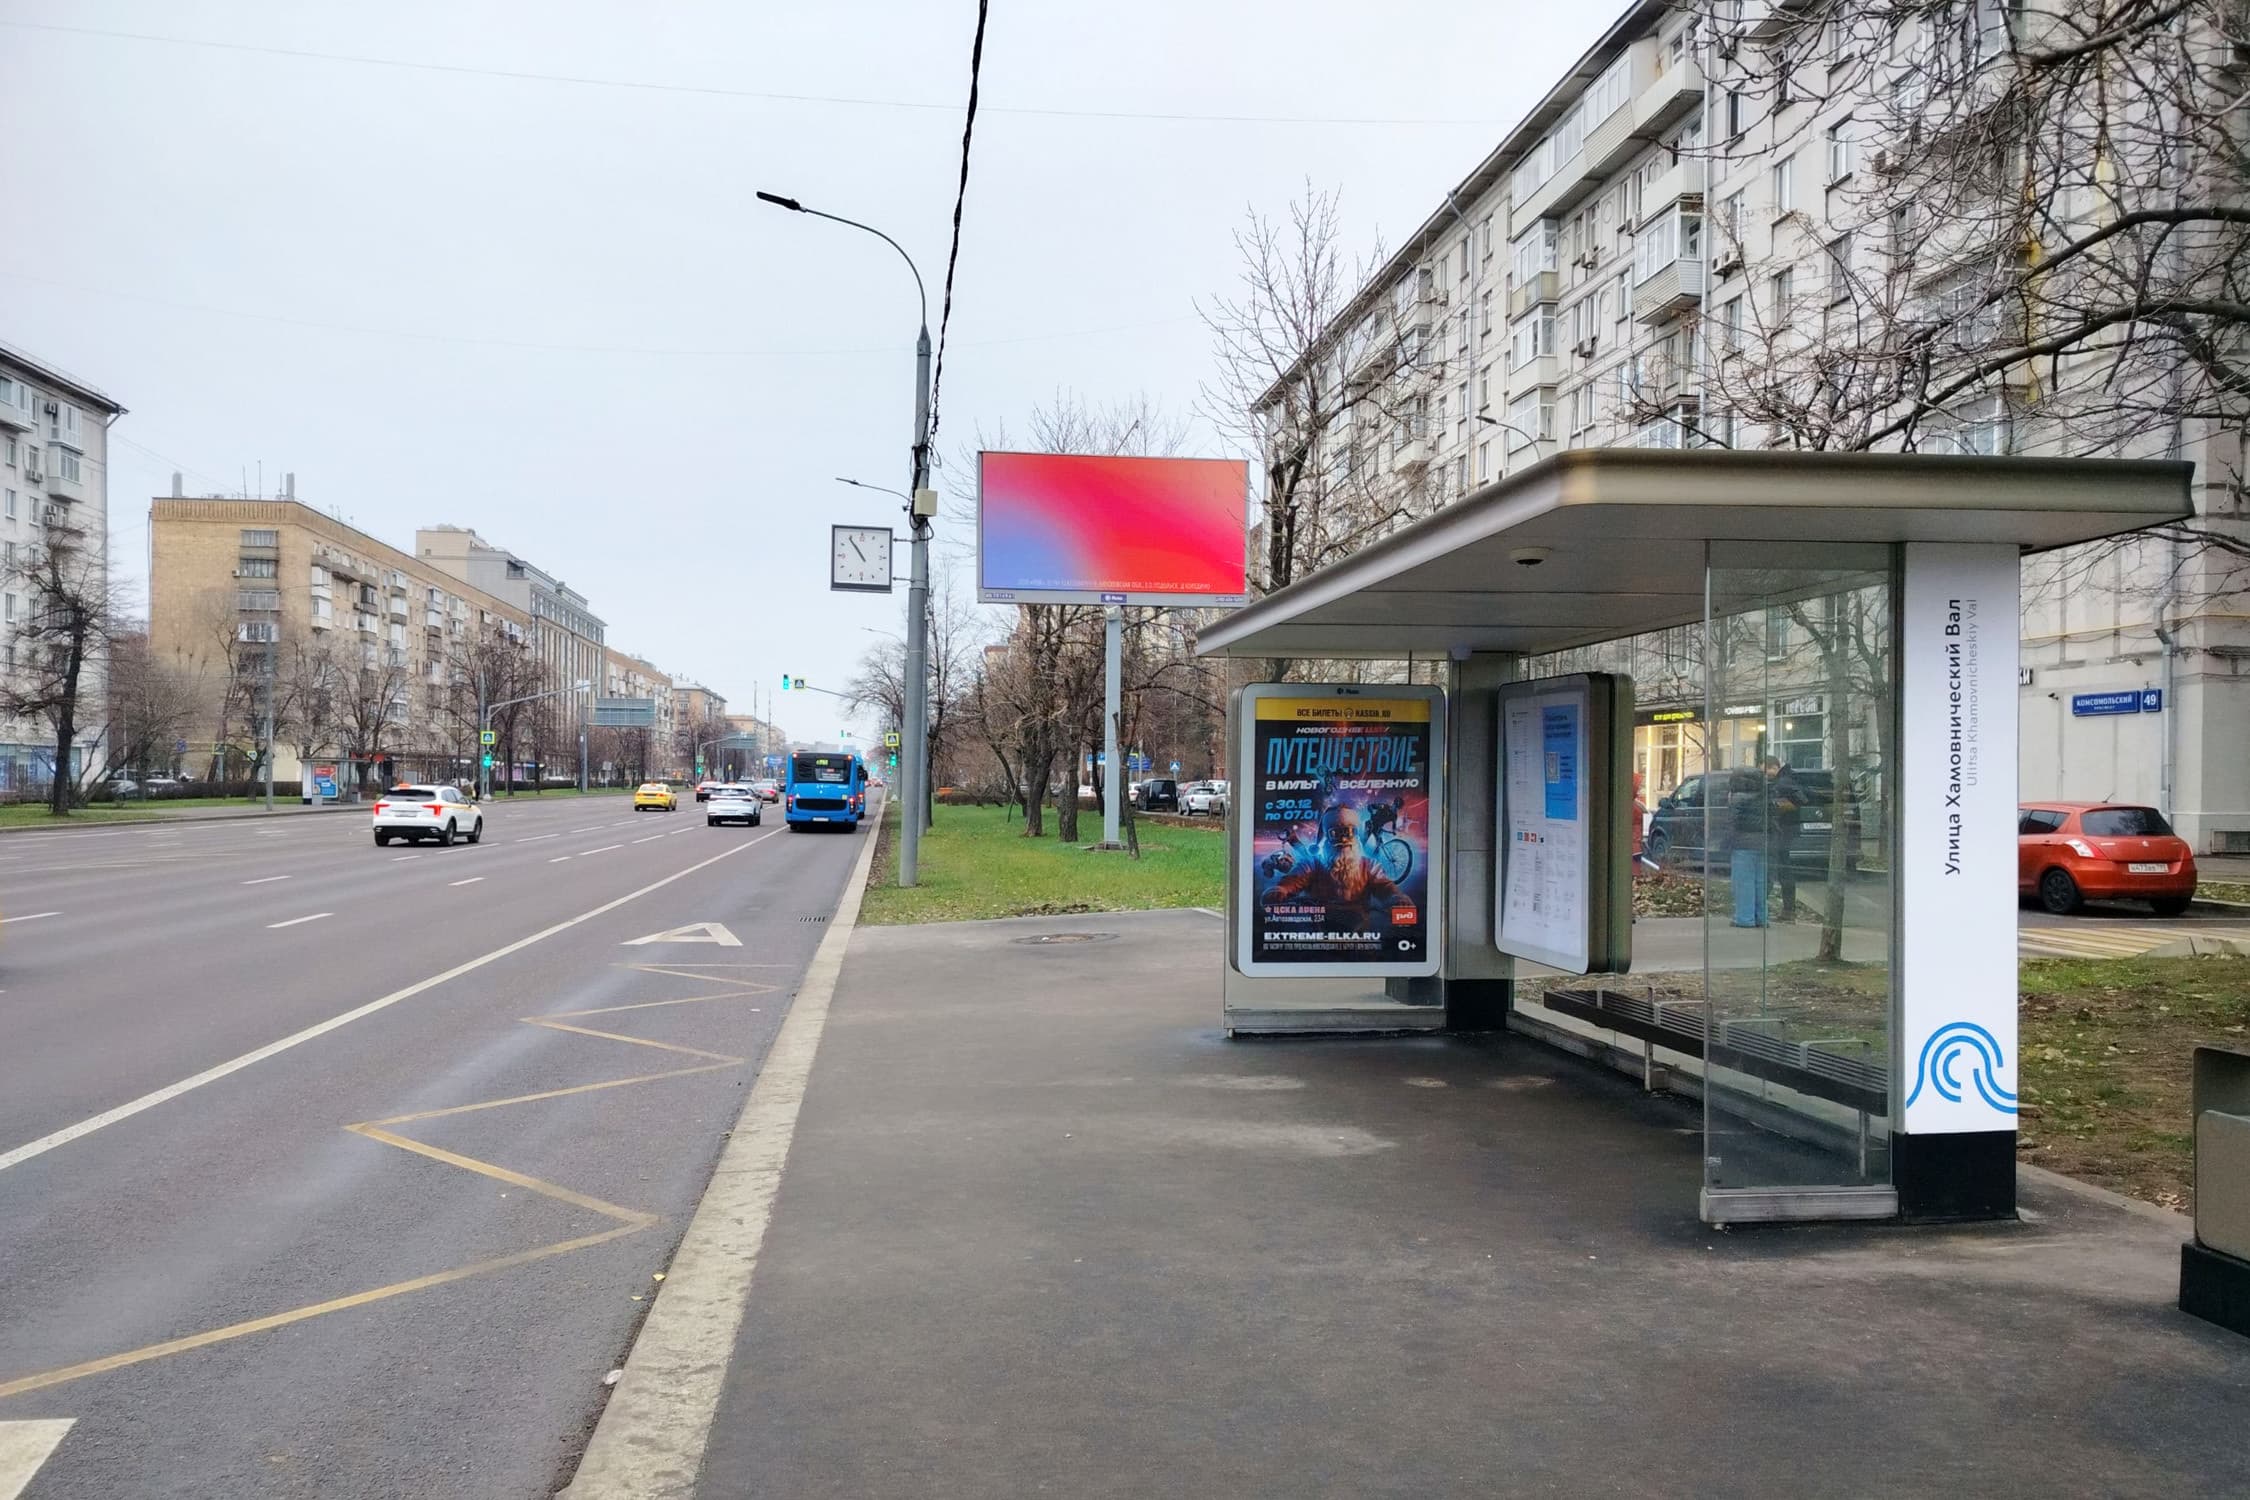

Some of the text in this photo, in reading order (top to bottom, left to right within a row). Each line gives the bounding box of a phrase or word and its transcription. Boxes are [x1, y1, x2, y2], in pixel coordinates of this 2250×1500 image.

[1966, 600, 1979, 786] Ulitsa Khamovnicheskiy Val
[2076, 694, 2132, 707] КОМСОМОЛЬСКИЙ
[2143, 694, 2157, 706] 49
[1296, 708, 1343, 717] ВСЕ БИЛЕТЫ
[1945, 600, 1963, 875] Улица Хамовнический Вал
[1265, 735, 1419, 775] ПУТЕШЕСТВИЕ
[1266, 779, 1419, 790] В МУЛЬТ ВСЕЛЕННУЮ
[1276, 799, 1312, 810] 30.12
[1265, 810, 1319, 821] по 07.01
[1273, 906, 1326, 915] ЦСКА АРЕНА
[1264, 932, 1381, 940] EXTREME-ELKA.RU
[1398, 940, 1416, 951] 0+
